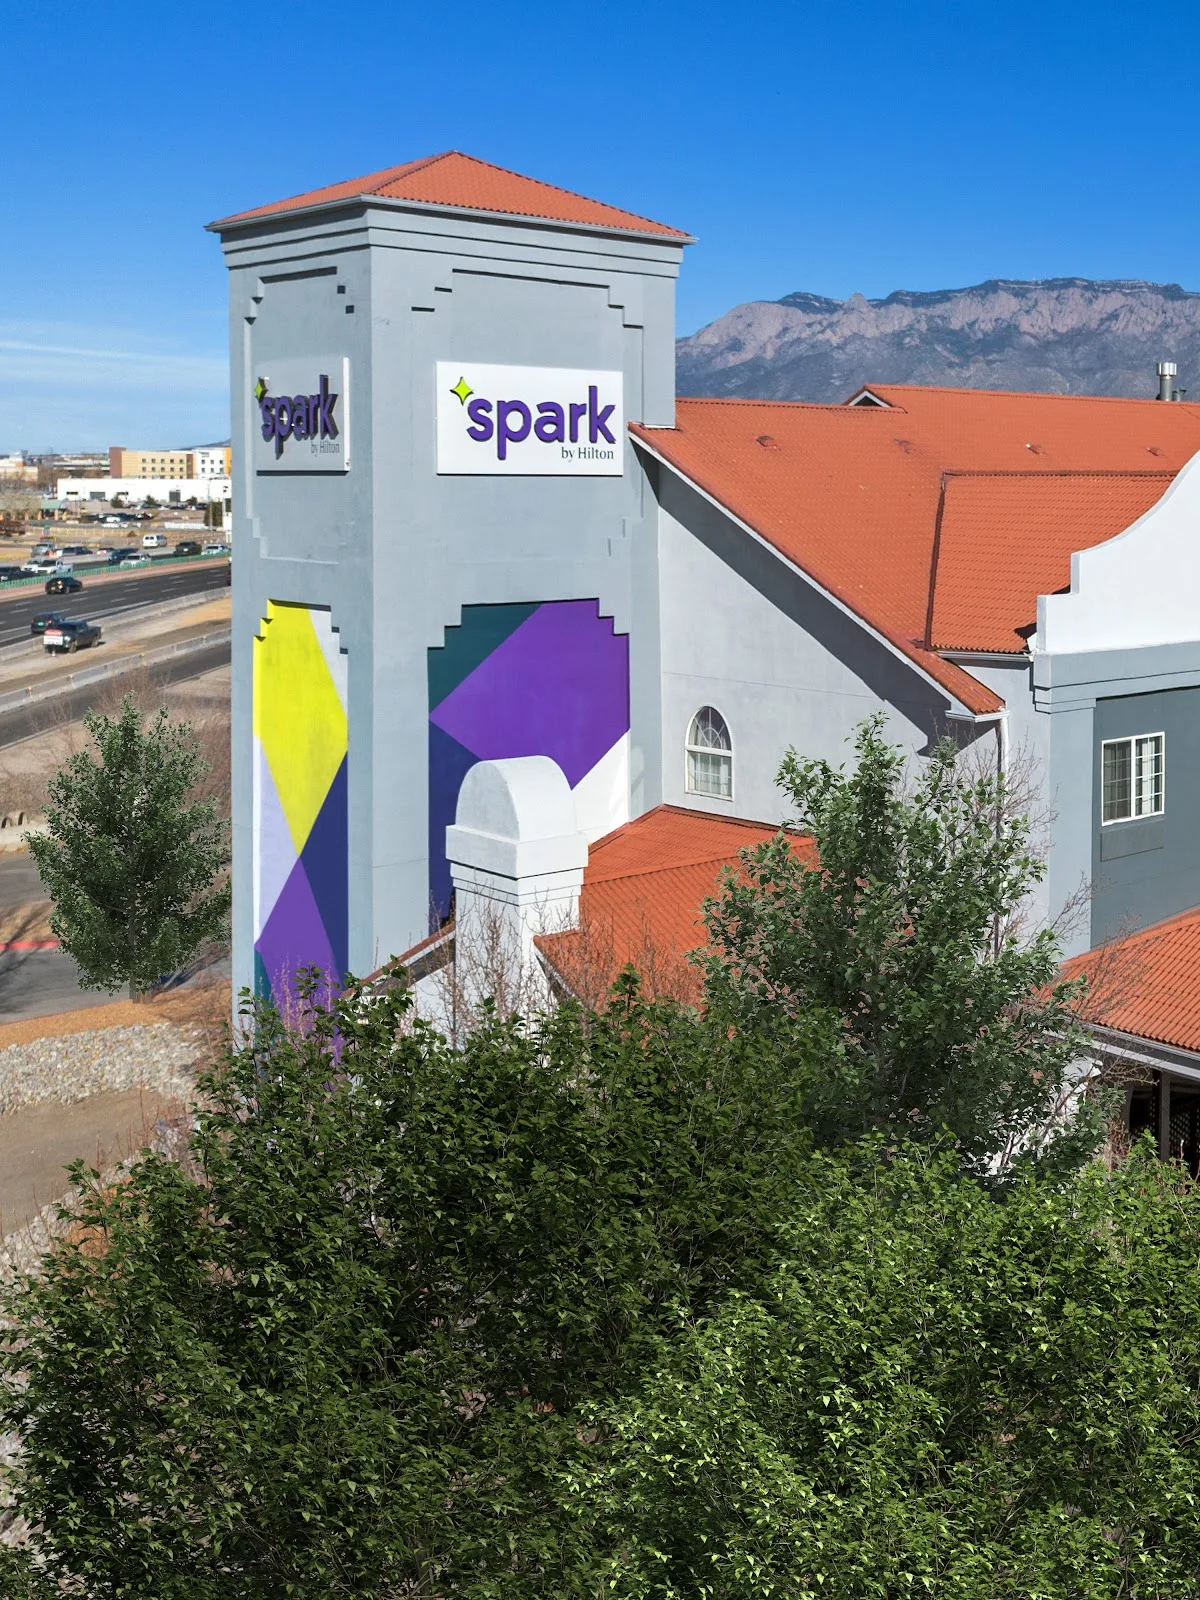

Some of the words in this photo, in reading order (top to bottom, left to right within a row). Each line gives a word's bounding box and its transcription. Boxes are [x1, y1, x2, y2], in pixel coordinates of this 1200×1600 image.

[261, 374, 339, 460] spark
[466, 385, 616, 460] spark
[311, 441, 318, 457] by
[319, 440, 340, 454] Hilton
[561, 446, 575, 463] by
[578, 447, 614, 460] Hilton
